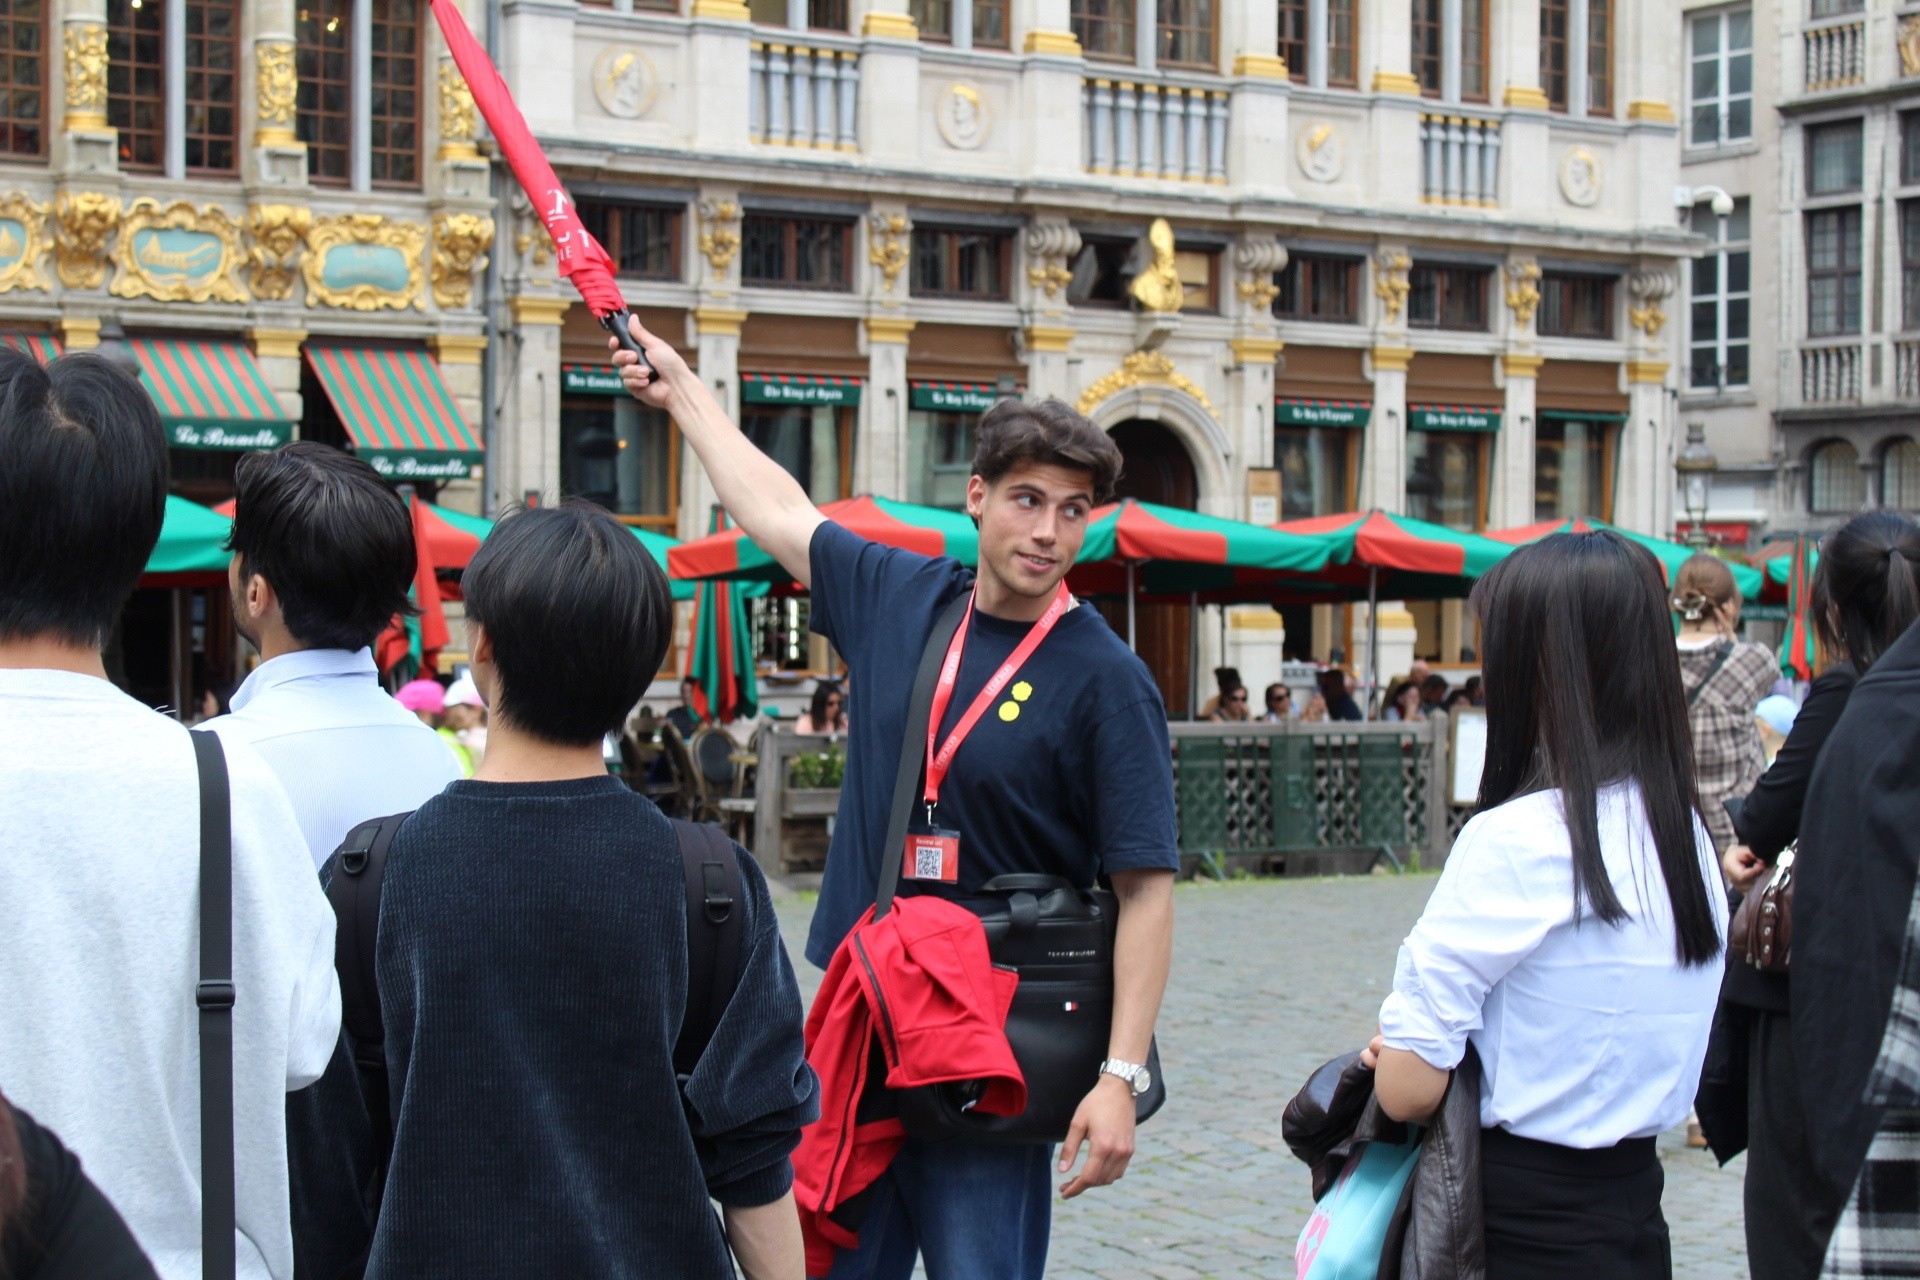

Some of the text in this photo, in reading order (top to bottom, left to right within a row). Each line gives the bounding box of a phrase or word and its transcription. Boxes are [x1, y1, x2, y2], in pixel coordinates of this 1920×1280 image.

[763, 384, 843, 401] The King of Spain
[175, 425, 200, 444] La
